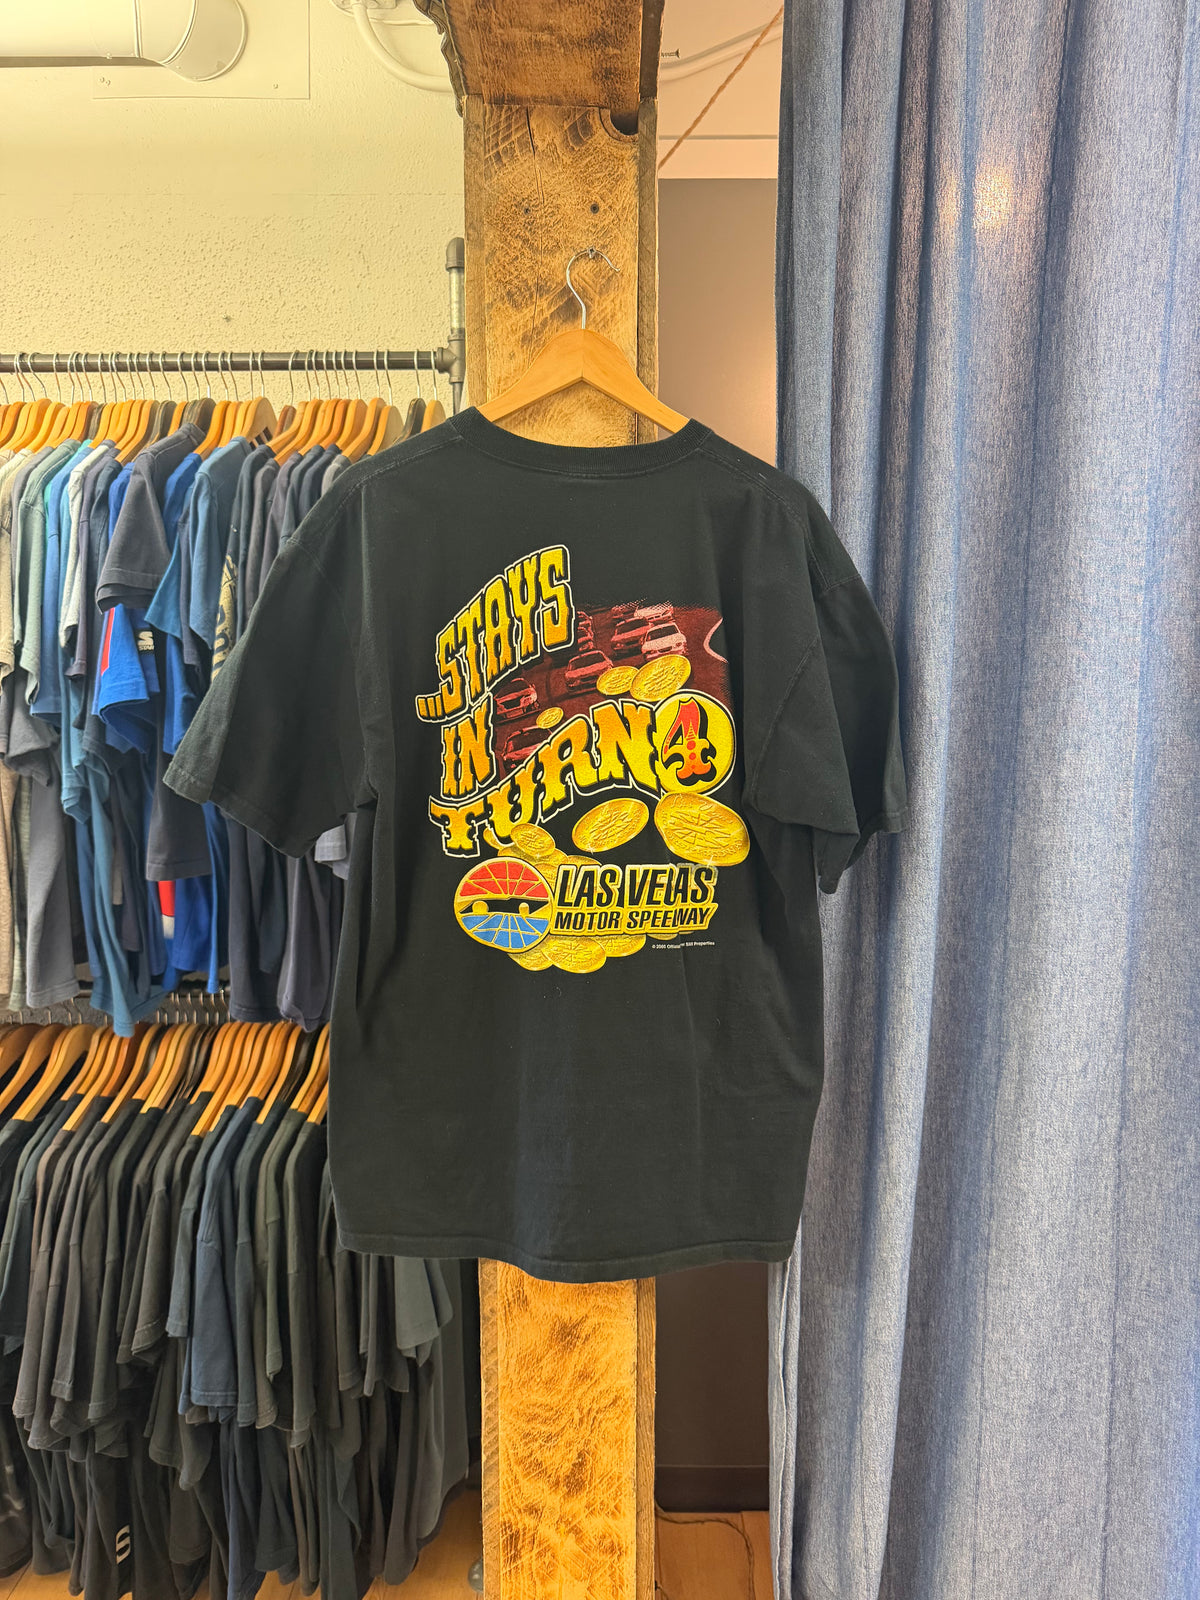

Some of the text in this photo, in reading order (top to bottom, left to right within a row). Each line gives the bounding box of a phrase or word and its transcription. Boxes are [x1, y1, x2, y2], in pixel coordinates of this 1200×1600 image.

[429, 697, 716, 858] TURN 4
[441, 694, 496, 799] IN
[554, 908, 711, 930] MOTOR SPEEWAY
[556, 867, 617, 908] LAS
